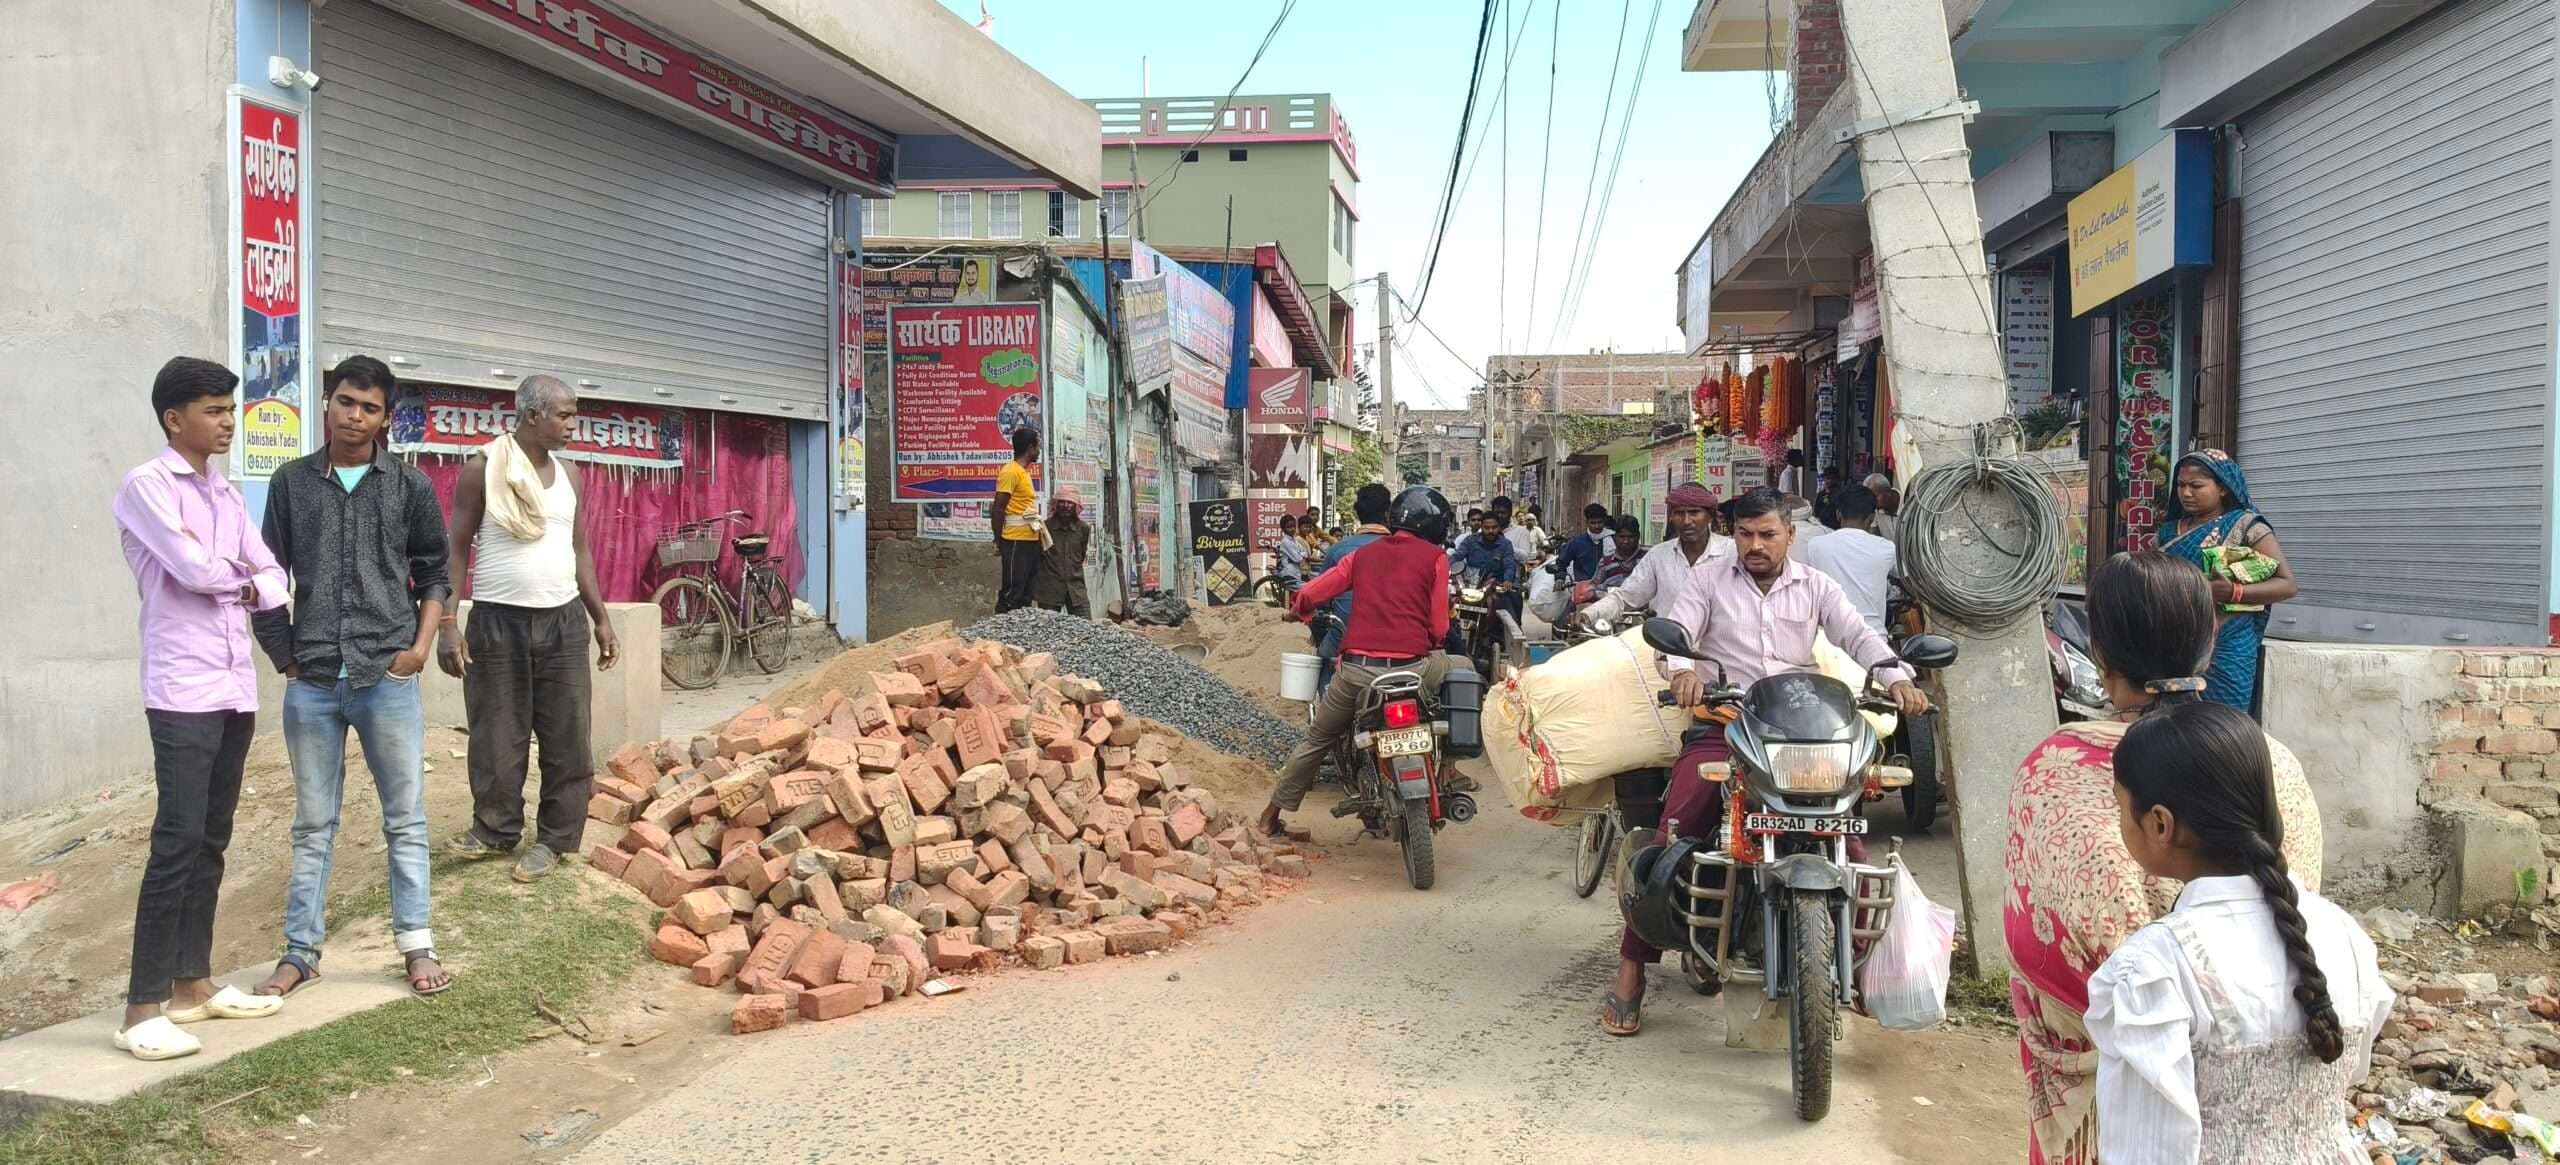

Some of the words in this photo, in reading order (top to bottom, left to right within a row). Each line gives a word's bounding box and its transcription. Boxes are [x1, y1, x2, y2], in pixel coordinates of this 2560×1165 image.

[488, 0, 669, 76] ार्थक
[689, 71, 876, 173] लाइब्रेरी
[244, 117, 297, 203] सार्थक
[245, 217, 296, 309] लाइब्रेरी
[896, 311, 962, 347] सार्थक
[967, 315, 1035, 346] LIBRARY
[935, 389, 957, 397] Facility
[258, 407, 271, 423] Run
[1260, 406, 1304, 416] HONDA
[924, 424, 946, 432] Facility
[246, 430, 277, 447] Abhishek
[279, 432, 298, 448] Yadav
[927, 441, 950, 449] Facility
[899, 452, 914, 461] Run
[927, 451, 959, 461] Abhishek
[961, 451, 982, 461] Yadav
[945, 466, 975, 477] Thana
[1257, 502, 1287, 512] Sales
[1257, 514, 1284, 525] Serv
[1196, 533, 1245, 552] Biryani
